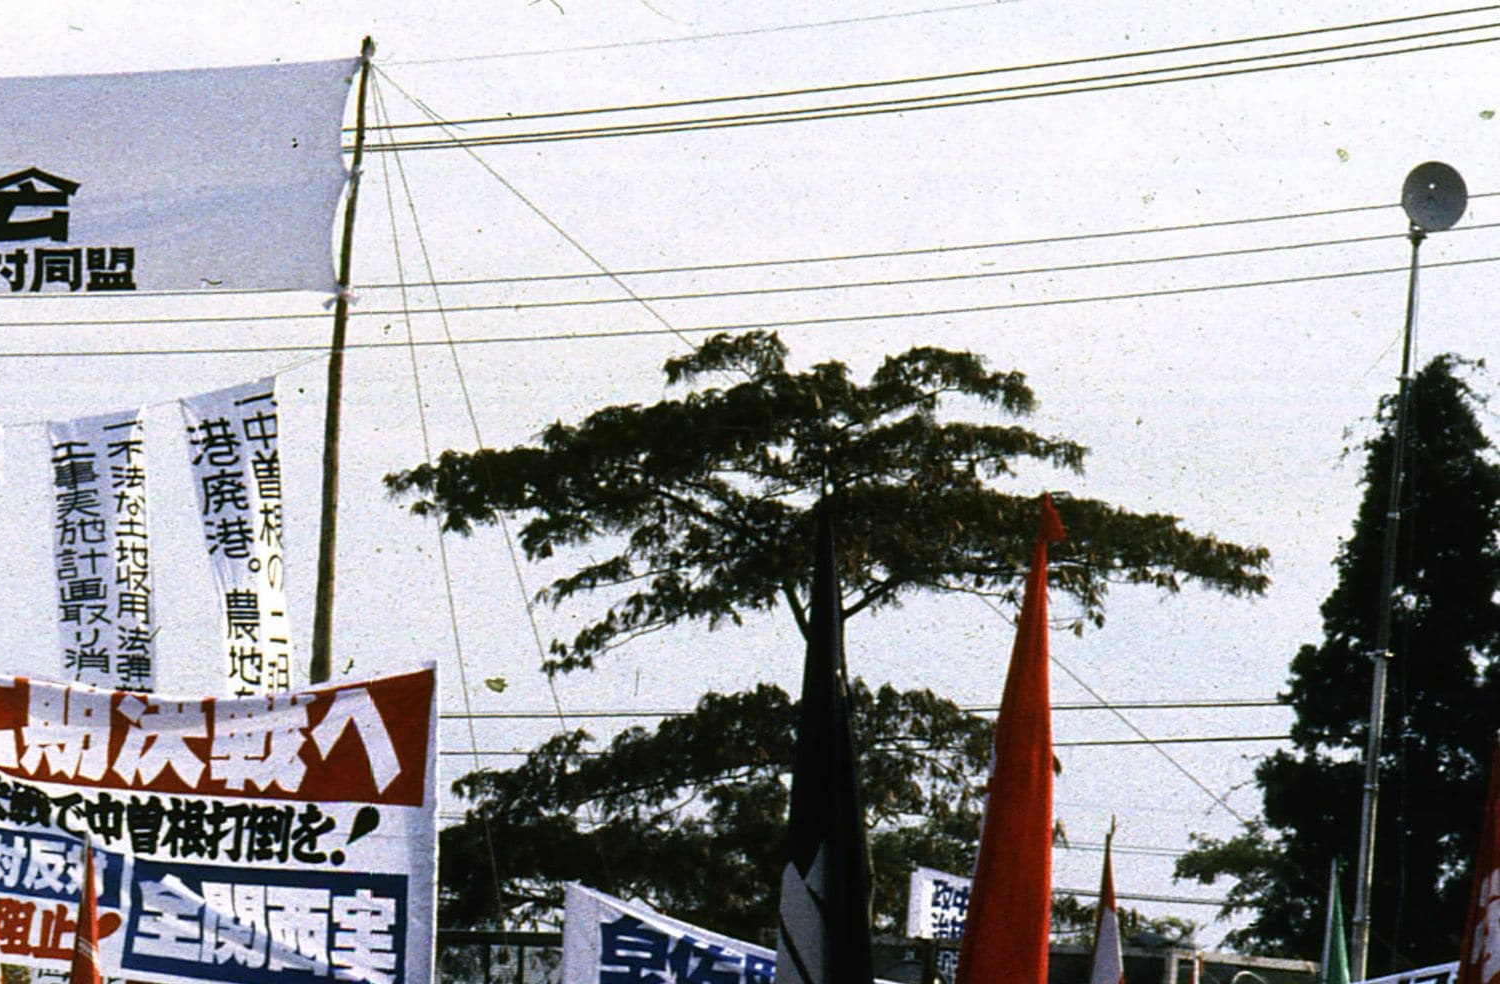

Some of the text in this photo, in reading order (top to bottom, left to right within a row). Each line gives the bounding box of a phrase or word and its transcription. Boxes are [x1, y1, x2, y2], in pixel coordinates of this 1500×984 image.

[102, 419, 155, 692] 一、不法な土地収用法弾
